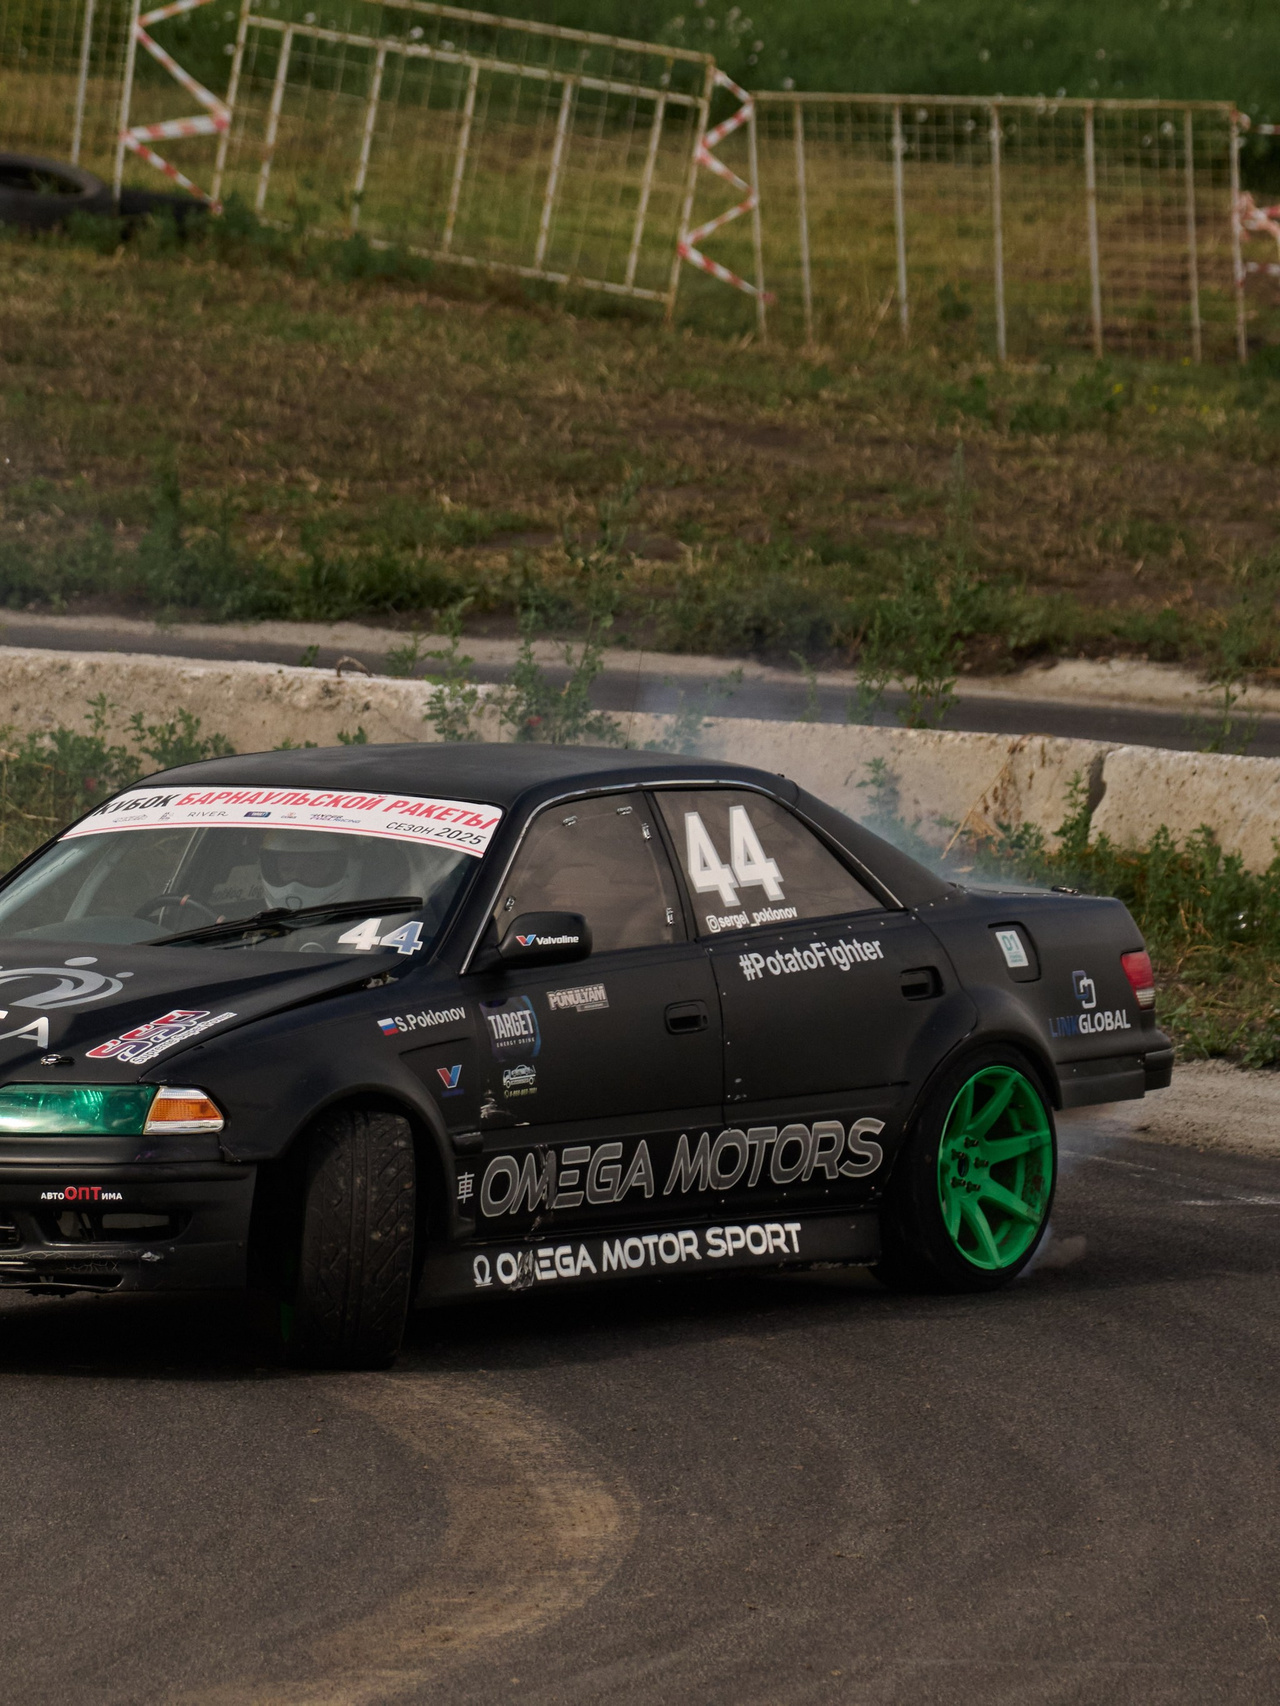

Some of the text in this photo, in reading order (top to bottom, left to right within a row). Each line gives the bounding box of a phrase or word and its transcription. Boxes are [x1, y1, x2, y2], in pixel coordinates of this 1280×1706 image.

[92, 793, 180, 816] КУБОК
[175, 791, 388, 811] БАРНАУЛЬСКОЙ
[382, 799, 500, 830] РАКЕТЫ
[385, 821, 486, 845] СЕЗОН 2025
[684, 805, 785, 907] 44
[338, 918, 423, 955] 44
[535, 934, 579, 945] Valvoline
[739, 939, 884, 981] #PotatoFighter
[394, 1006, 466, 1033] S.Poklonov
[487, 1009, 534, 1039] TARGET
[496, 1040, 517, 1048] ENERGY
[481, 1117, 885, 1217] OMEGA MOTORS
[457, 1172, 475, 1203] 車
[602, 1233, 701, 1272] MOTOR
[706, 1222, 801, 1257] SPORT
